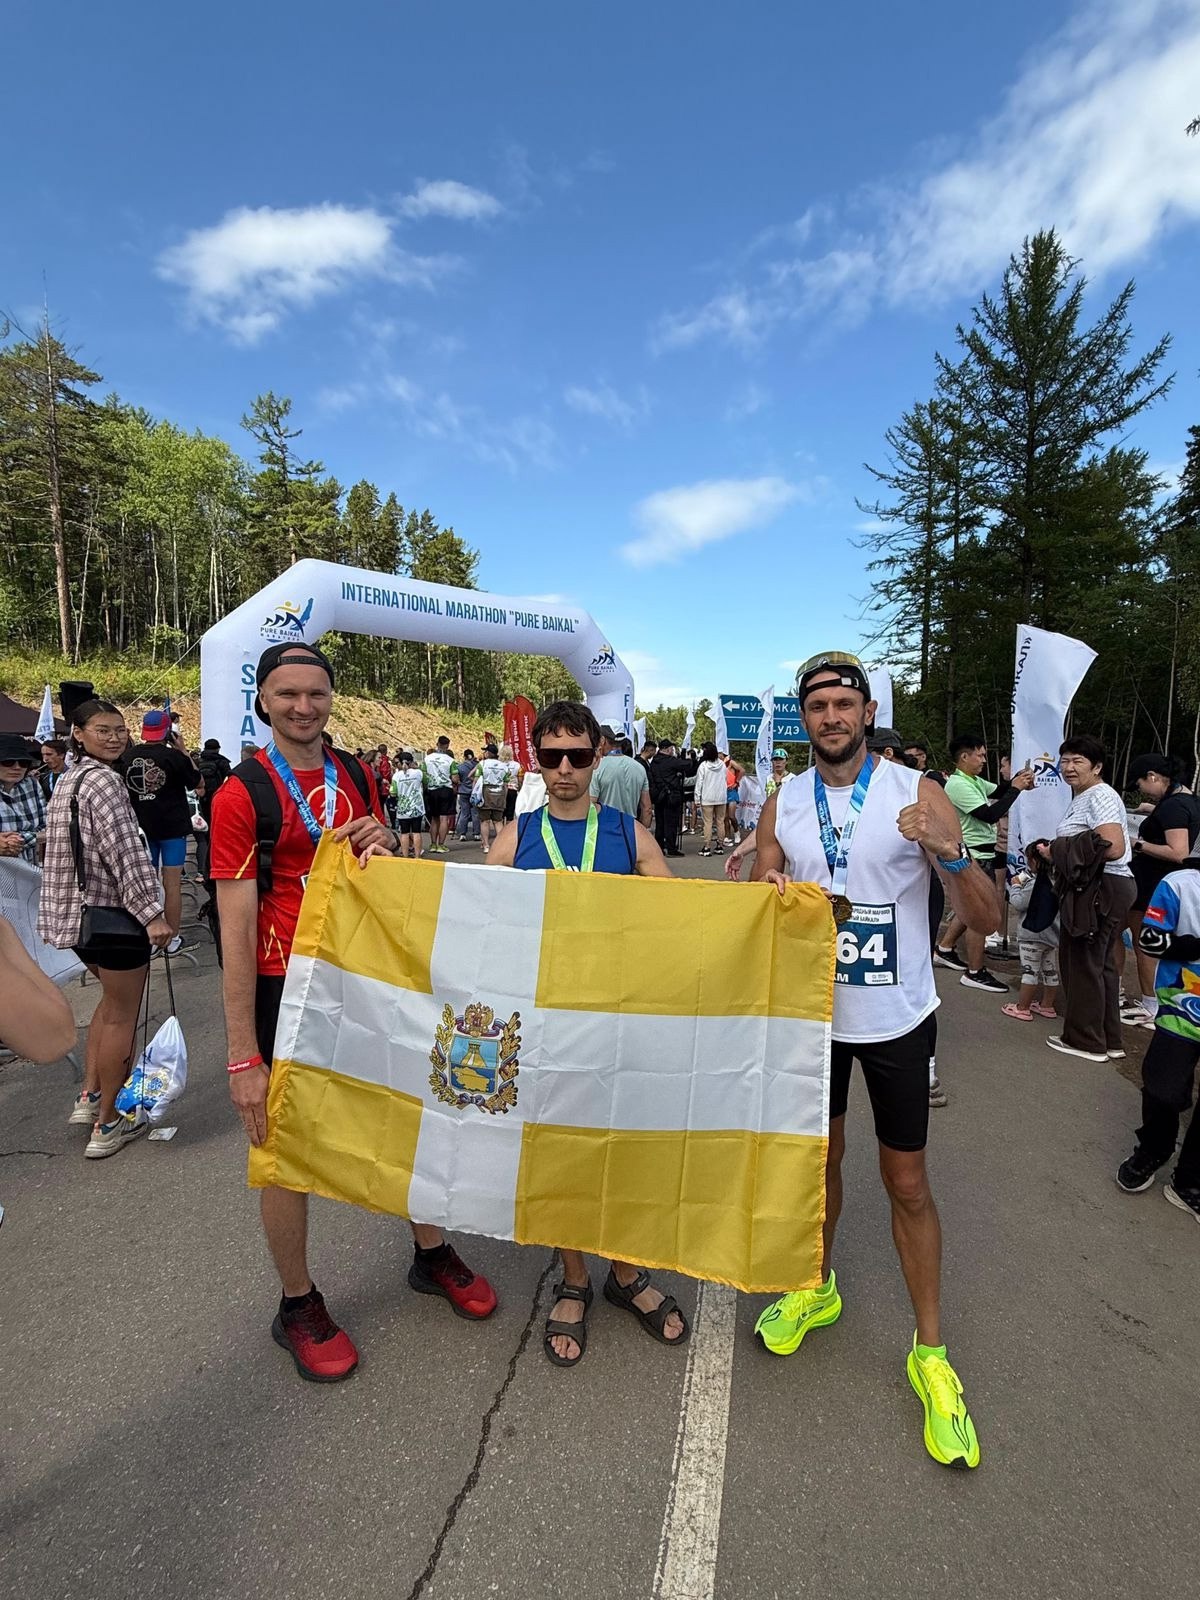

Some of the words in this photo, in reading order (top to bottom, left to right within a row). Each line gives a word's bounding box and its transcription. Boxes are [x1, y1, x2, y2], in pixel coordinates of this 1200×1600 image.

[341, 581, 443, 616] INTERNATIONAL
[445, 600, 507, 625] MARATHON
[509, 610, 540, 629] "PURE
[542, 615, 580, 633] BAIKAL"
[260, 627, 277, 635] PURE
[280, 630, 300, 638] BAIKAL
[741, 702, 801, 713] КУРМКА
[741, 724, 800, 736] УЛ-УДЭ
[836, 931, 888, 966] 64
